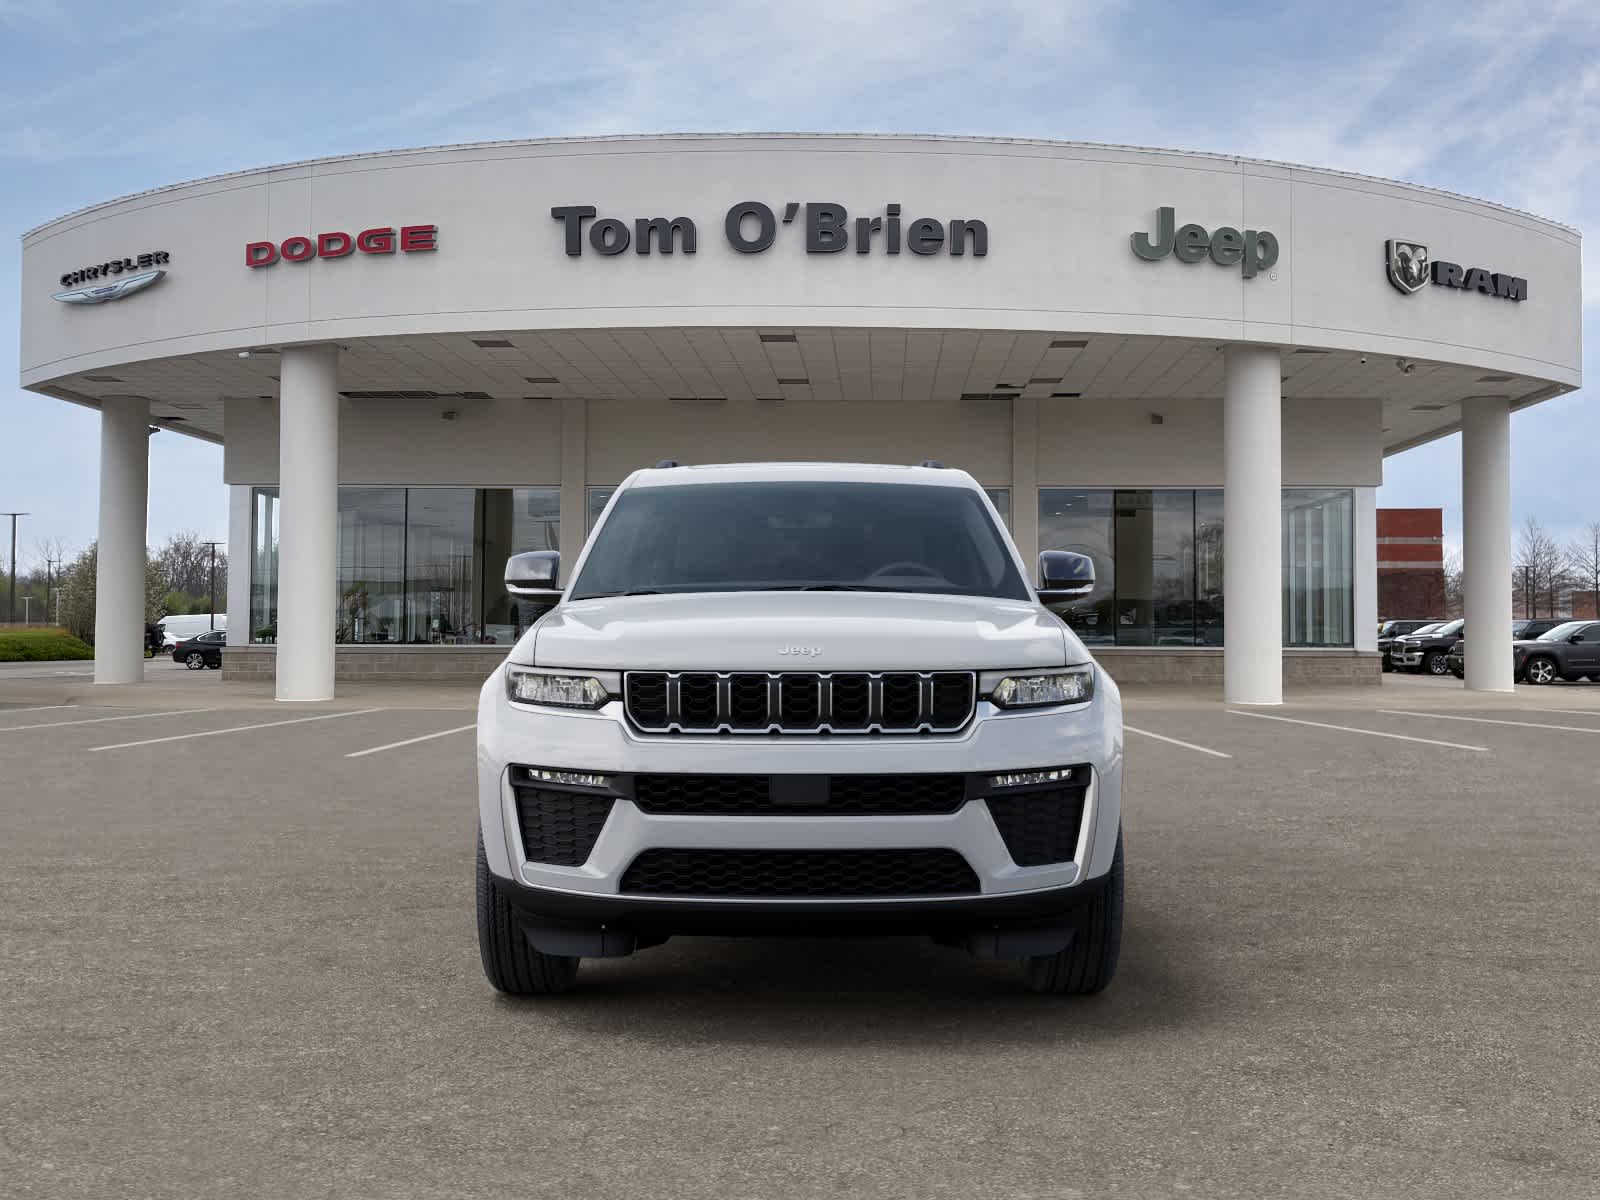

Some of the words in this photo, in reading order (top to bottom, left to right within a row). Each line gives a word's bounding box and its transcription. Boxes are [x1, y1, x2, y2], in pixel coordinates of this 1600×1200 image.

[245, 224, 438, 269] DODGE
[551, 205, 697, 256] Tom
[725, 201, 988, 256] O'Brien
[1130, 206, 1279, 280] Jeep
[60, 249, 170, 287] CHRYSLER
[1430, 260, 1528, 301] RAM
[777, 642, 822, 659] Jeep
